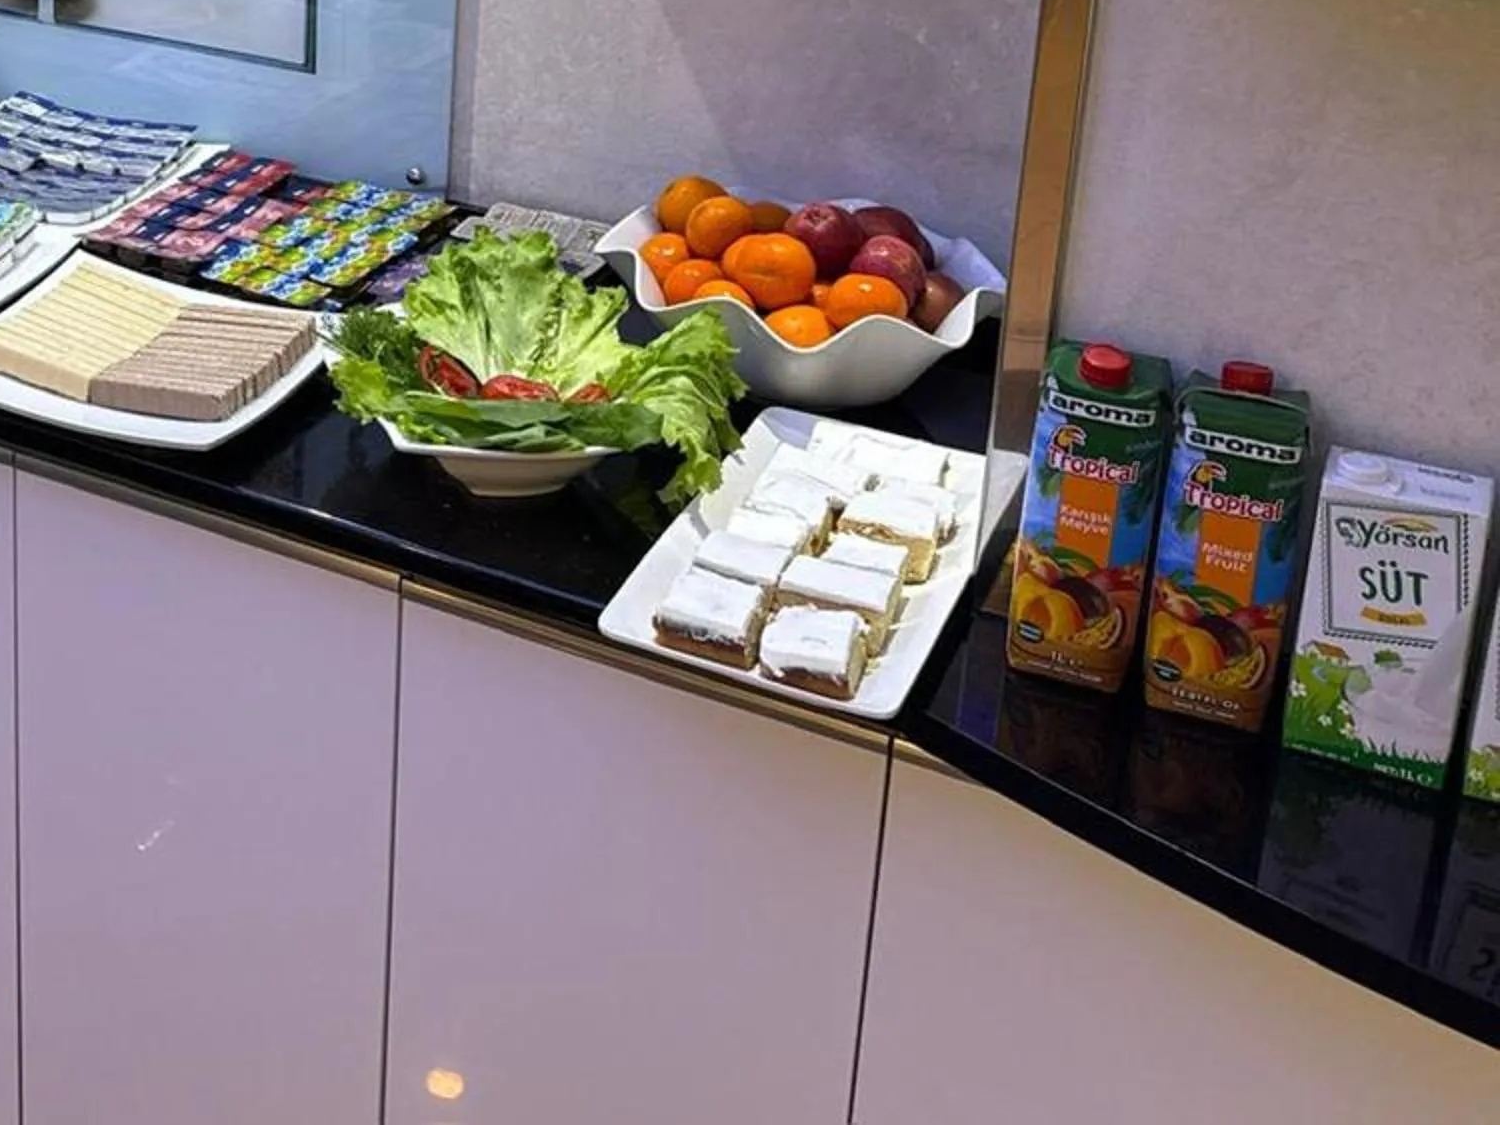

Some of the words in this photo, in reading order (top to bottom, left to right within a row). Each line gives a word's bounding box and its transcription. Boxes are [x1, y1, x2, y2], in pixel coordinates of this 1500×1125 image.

[1051, 396, 1151, 424] aroma
[1047, 445, 1140, 483] Tropical
[1189, 430, 1296, 461] aroma
[1185, 481, 1284, 522] Tropical
[1357, 519, 1449, 555] Yörsan
[1359, 560, 1429, 606] SÜT
